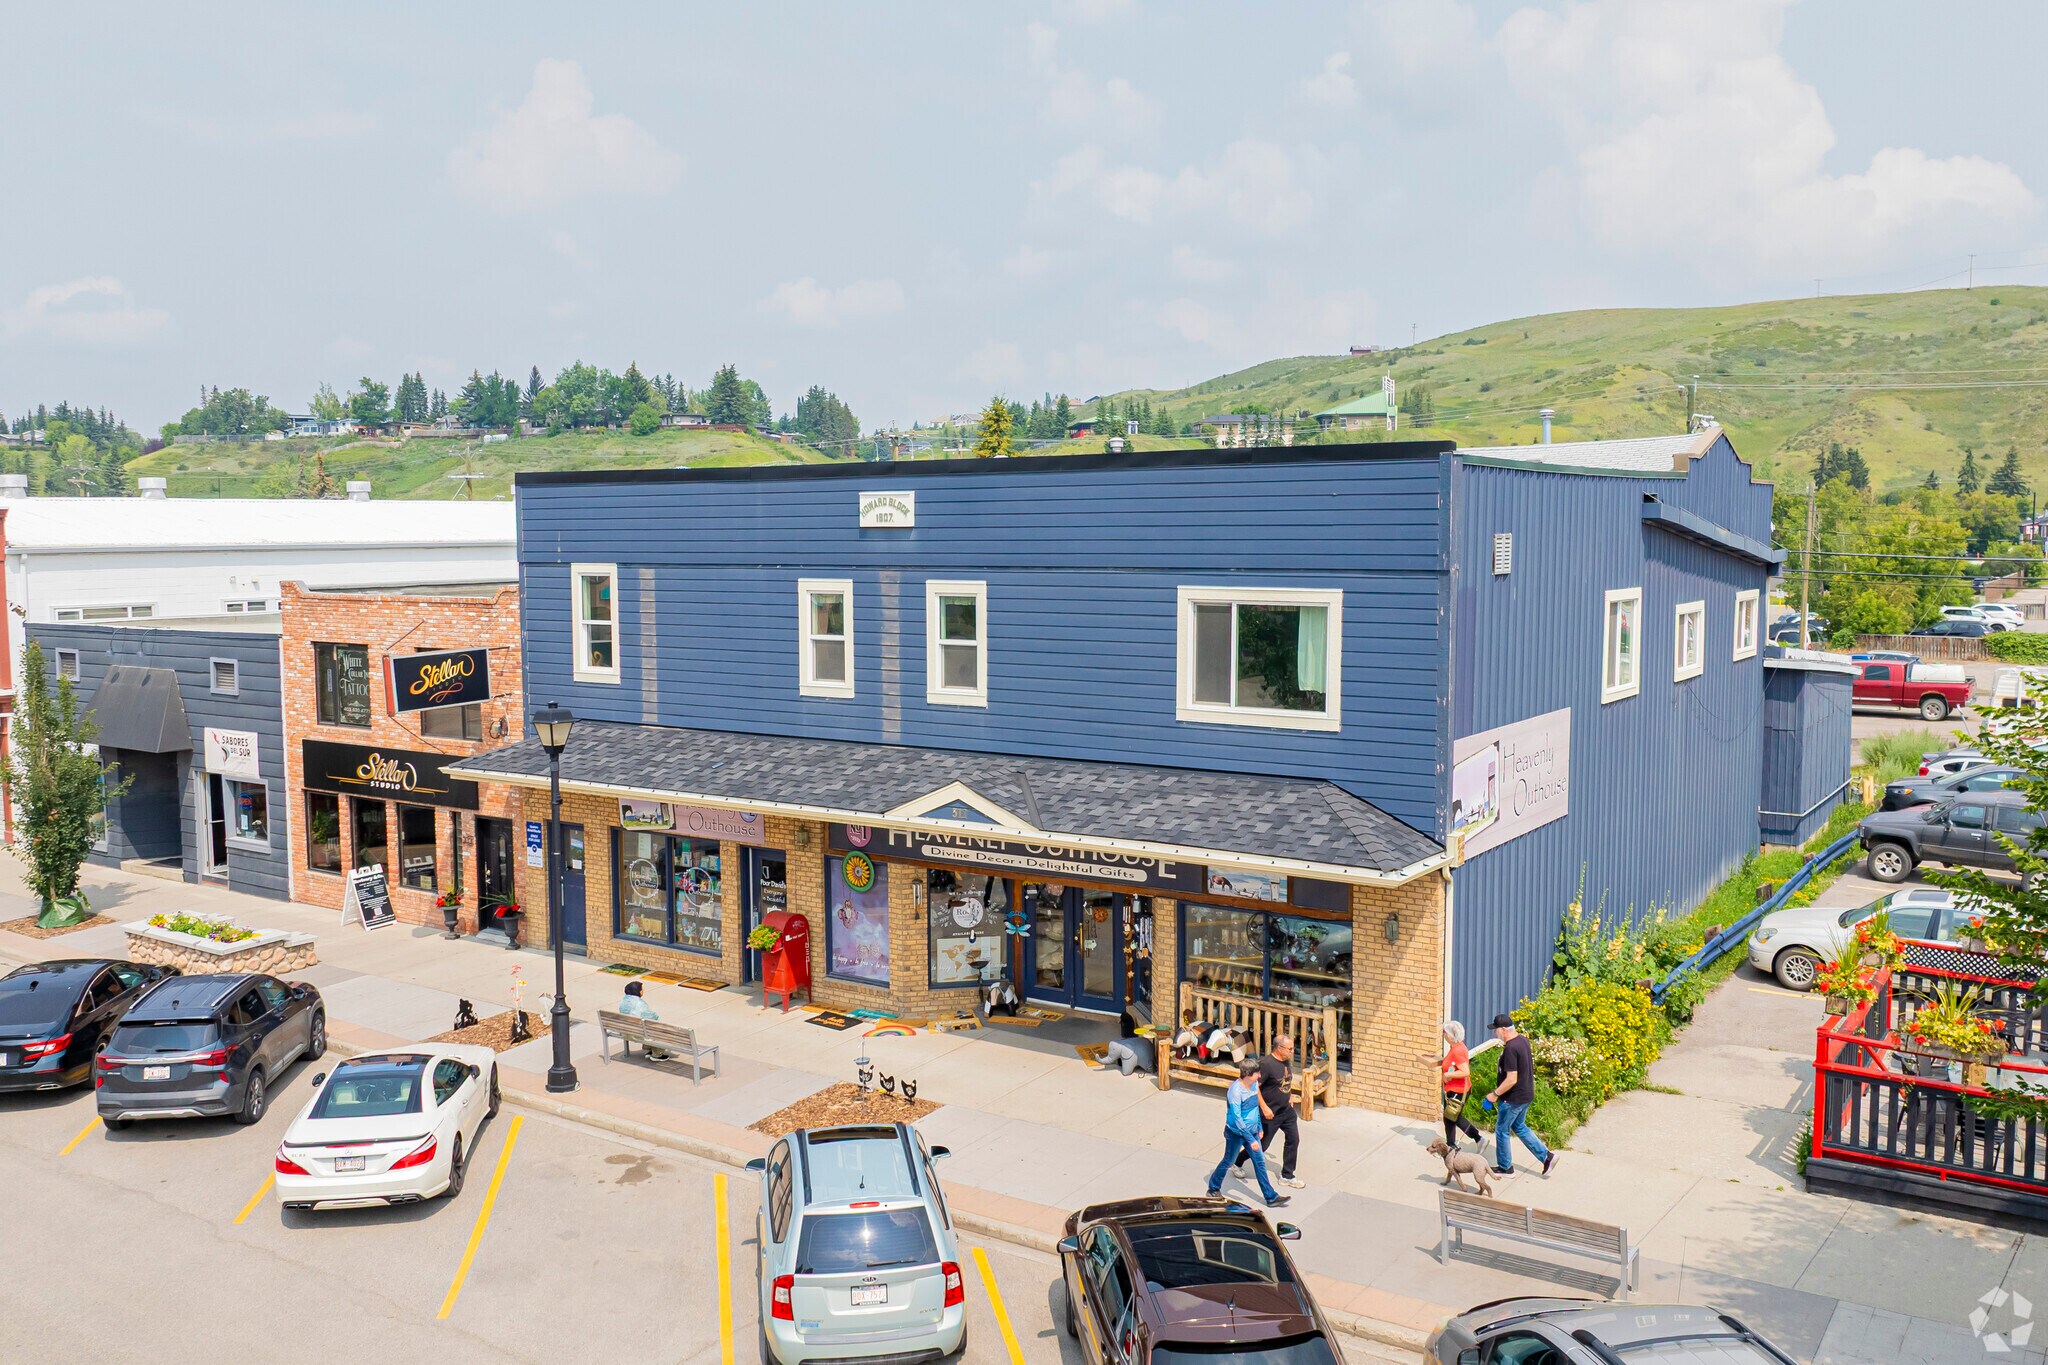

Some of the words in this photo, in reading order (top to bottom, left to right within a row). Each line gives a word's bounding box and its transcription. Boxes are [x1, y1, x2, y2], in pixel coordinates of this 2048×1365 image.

[860, 497, 887, 518] HOWARD
[888, 497, 911, 518] BLOCK
[410, 654, 474, 694] Stellar
[222, 736, 248, 746] SABORES
[239, 748, 251, 757] SUR
[356, 752, 417, 791] Stellar
[1503, 732, 1554, 783] Heavenly
[370, 780, 400, 790] STUDIO
[1513, 772, 1567, 816] Outhouse
[689, 811, 756, 836] Outhouse
[931, 847, 970, 859] Divine
[1026, 858, 1092, 874] Delightful
[1099, 867, 1134, 879] Gifts
